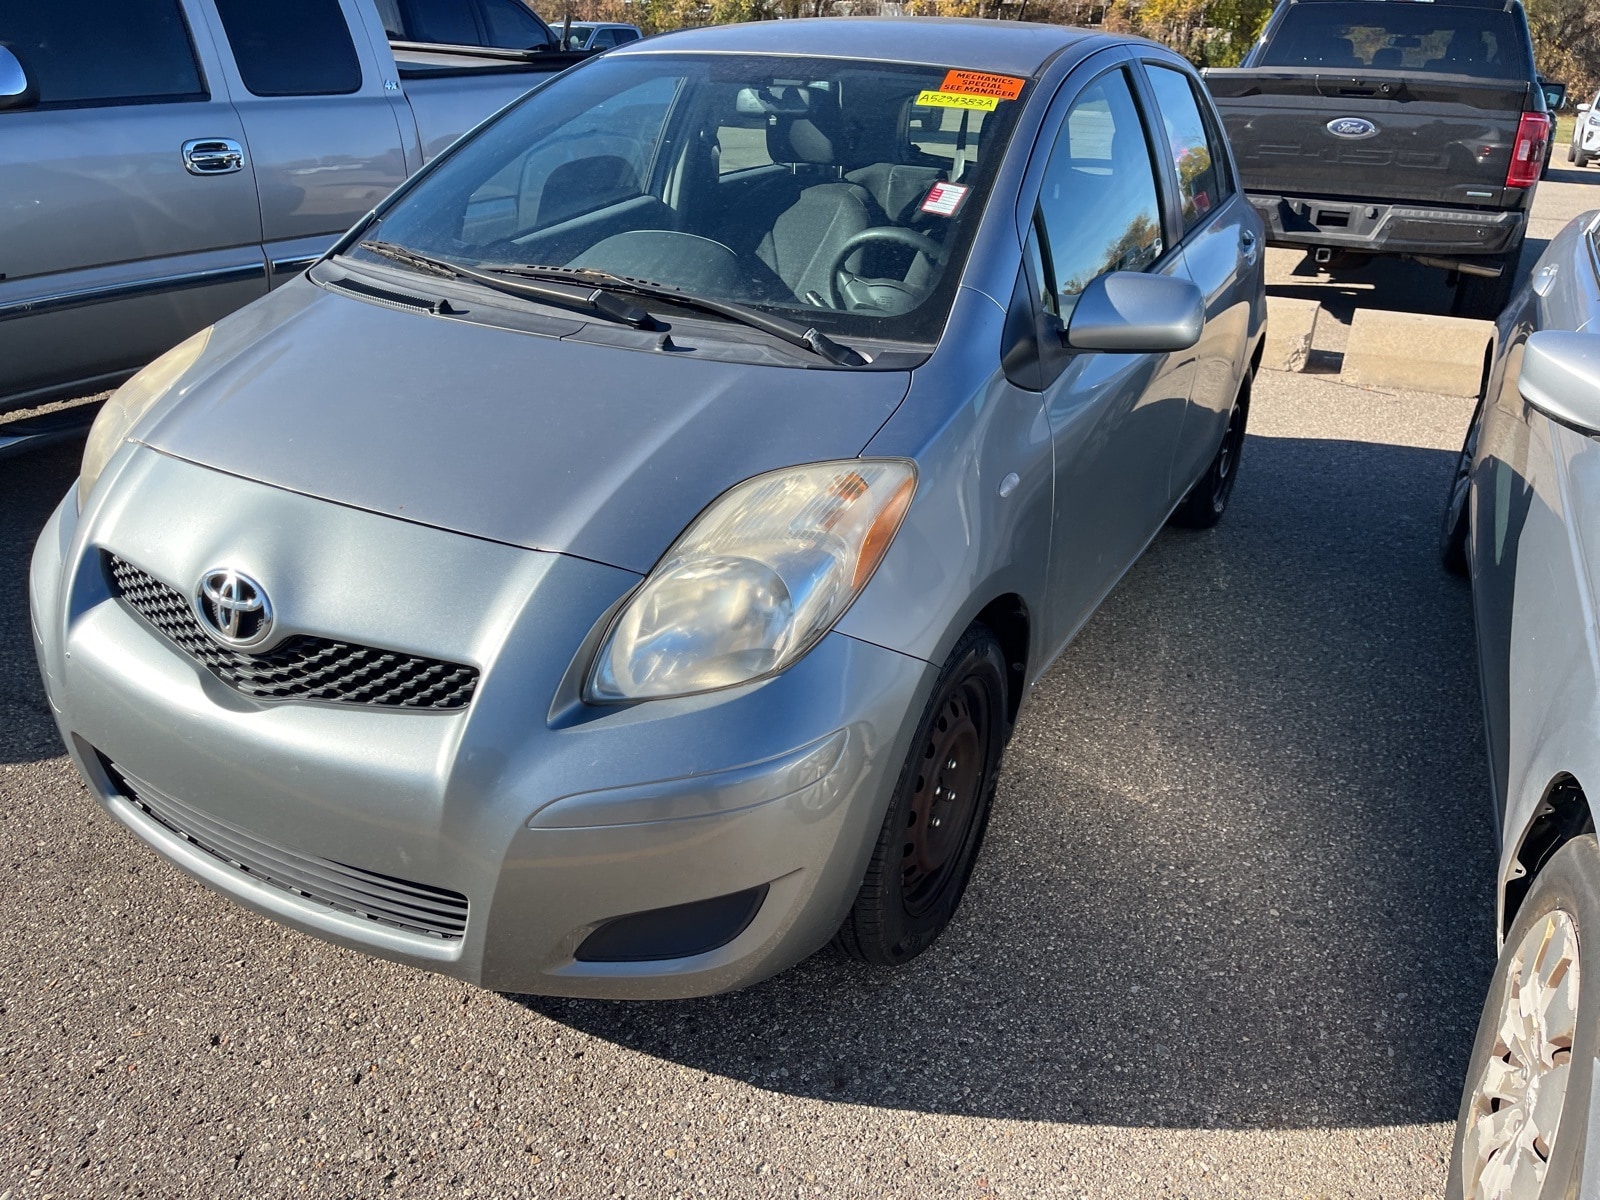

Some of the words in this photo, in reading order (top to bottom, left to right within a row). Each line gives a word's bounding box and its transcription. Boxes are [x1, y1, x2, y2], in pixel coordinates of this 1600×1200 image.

[956, 73, 1013, 85] MECHANICS
[962, 80, 1001, 89] SPECIAL
[964, 86, 1015, 97] MANAGER
[1337, 121, 1364, 133] Ford
